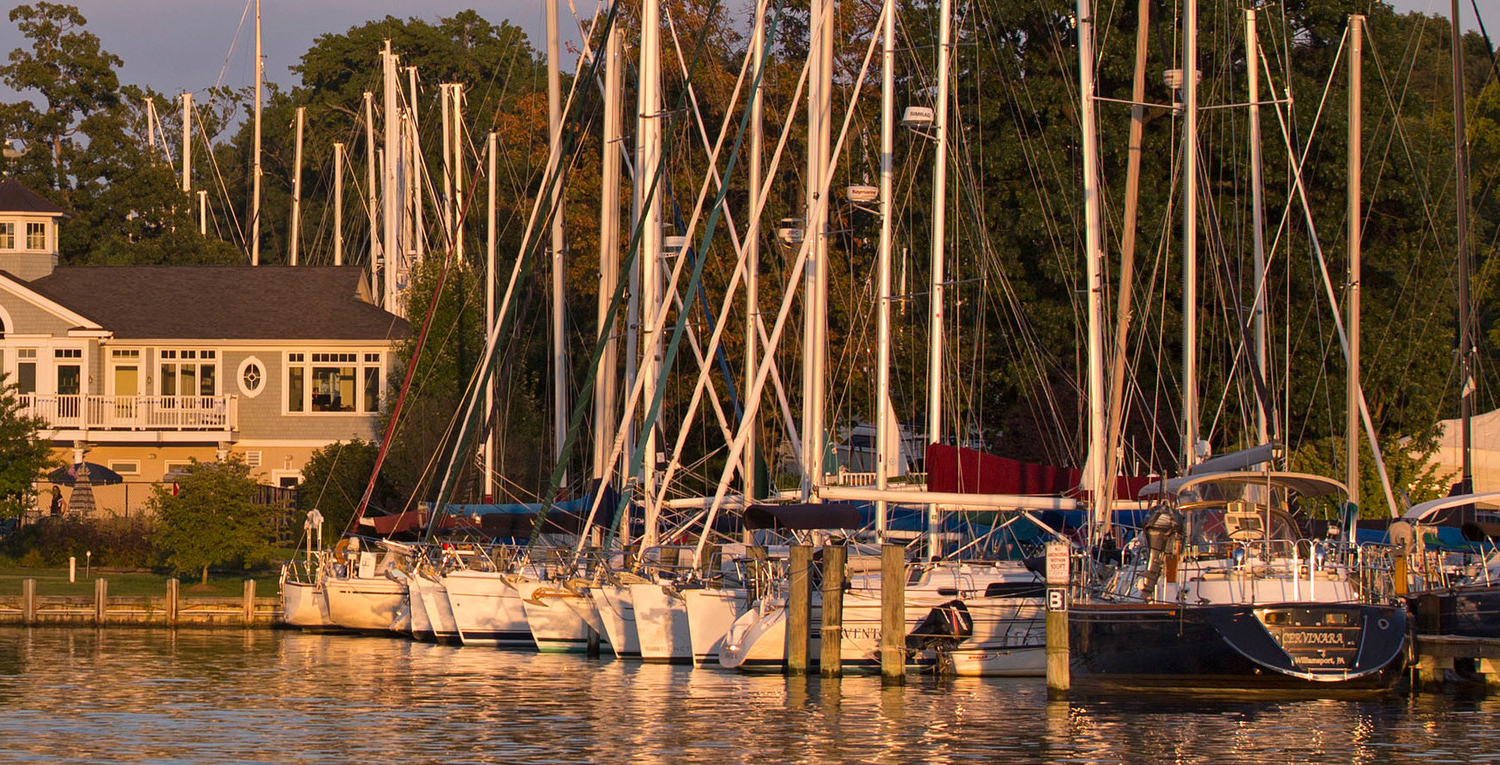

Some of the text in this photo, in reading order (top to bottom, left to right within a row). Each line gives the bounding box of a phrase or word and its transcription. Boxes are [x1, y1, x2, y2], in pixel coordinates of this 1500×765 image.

[1050, 592, 1062, 608] B
[1282, 632, 1343, 644] CERVINARA
[1295, 656, 1335, 665] Williamsport,
